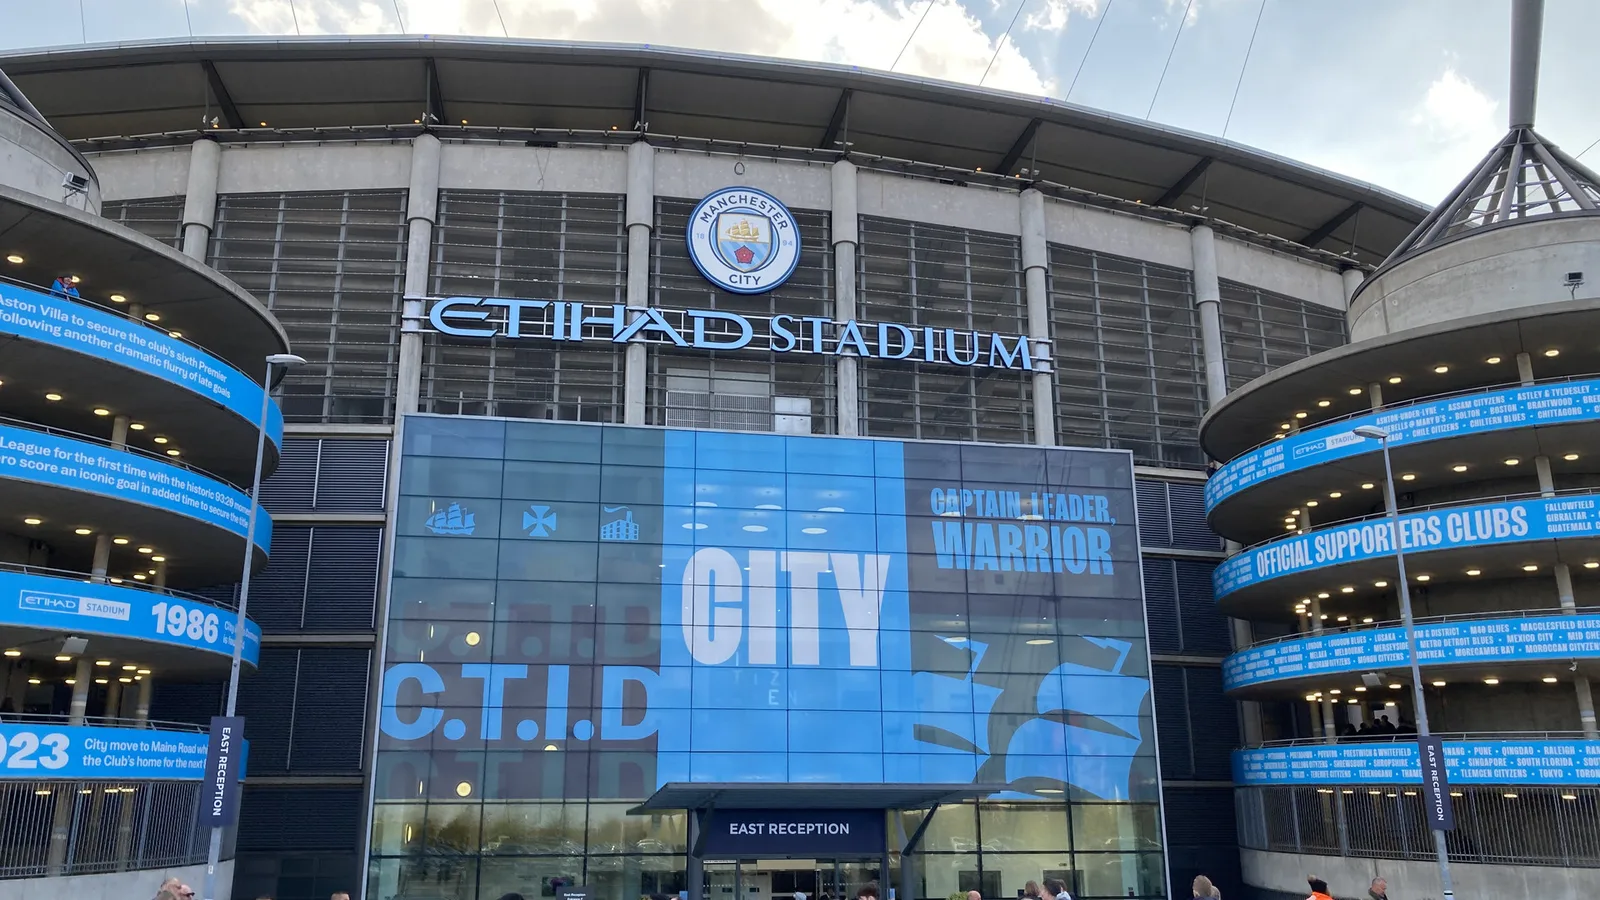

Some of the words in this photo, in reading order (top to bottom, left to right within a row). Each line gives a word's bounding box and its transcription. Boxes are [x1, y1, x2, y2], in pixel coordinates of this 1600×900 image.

[700, 195, 788, 229] MANCHESTER
[729, 274, 761, 285] CITY
[0, 294, 36, 314] Aston
[40, 304, 68, 323] Villa
[71, 314, 85, 326] to
[87, 320, 127, 340] secure
[128, 332, 147, 347] the
[148, 340, 176, 358] club's
[176, 351, 198, 368] sixth
[199, 360, 227, 383] Premier
[429, 297, 754, 350] ETIHAD
[770, 314, 1034, 371] STADIUM
[0, 309, 61, 337] following
[64, 329, 113, 349] another
[114, 342, 162, 367] dramatic
[163, 359, 189, 380] flurry
[189, 369, 198, 381] of
[198, 373, 213, 388] late
[213, 382, 231, 399] goals
[1448, 400, 1471, 411] ASSAM
[1473, 396, 1505, 408] CITYZENS
[1517, 391, 1543, 401] ASTLEY
[1544, 389, 1550, 398] &
[1552, 385, 1590, 397] TYLDESLEY
[1412, 427, 1430, 438] CHILE
[1470, 415, 1502, 428] CHILTERN
[1503, 412, 1526, 424] BLUES
[1537, 406, 1582, 419] CHITTAGONG
[1416, 416, 1434, 426] MARY
[1455, 410, 1480, 420] BOLTON
[1490, 404, 1517, 415] BOSTON
[1527, 398, 1572, 410] BRANTWOOD
[1295, 442, 1325, 456] ETIHAD
[0, 436, 51, 456] League
[53, 446, 72, 460] for
[75, 451, 95, 466] the
[97, 456, 121, 471] first
[123, 463, 147, 478] time
[148, 470, 170, 484] with
[171, 476, 186, 489] the
[186, 480, 215, 500] historic
[234, 501, 251, 516] momen
[19, 458, 58, 473] score
[60, 466, 77, 477] an
[79, 467, 115, 486] iconic
[116, 478, 139, 491] goal
[141, 482, 151, 494] in
[152, 485, 181, 504] added
[182, 494, 200, 510] time
[200, 500, 208, 512] to
[209, 504, 230, 520] secure
[1032, 491, 1116, 527] LEADER,
[1544, 500, 1595, 512] FALLOWFIELD
[1546, 511, 1587, 522] GIBRALTAR
[1547, 522, 1592, 533] GUATEMALA
[931, 521, 1114, 575] WARRIOR
[1256, 539, 1313, 578] OFFICIAL
[1314, 515, 1443, 563] SUPPORTERS
[1446, 506, 1529, 543] CLUBS
[25, 596, 76, 609] ETIHAD
[86, 603, 125, 616] STADIUM
[681, 547, 891, 667] CITY
[152, 601, 219, 644] 1986
[1431, 627, 1460, 637] DISTRICT
[1487, 624, 1510, 634] BLUES
[1520, 620, 1576, 631] MACCLESFIELD
[1577, 619, 1600, 629] BLUES
[1420, 638, 1443, 649] METRO
[1444, 637, 1470, 647] DETROIT
[1472, 635, 1494, 645] BLUES
[1506, 633, 1536, 643] MEXICO
[1537, 632, 1554, 642] CITY
[1567, 631, 1583, 641] MID
[1455, 646, 1500, 657] MORECAMBE
[1501, 645, 1515, 655] BAY
[1525, 643, 1568, 653] MOROCCAN
[379, 662, 660, 741] C.T.I.D
[84, 738, 108, 753] City
[109, 741, 138, 752] move
[140, 741, 150, 752] to
[151, 741, 177, 753] Maine
[177, 742, 197, 754] Road
[220, 727, 231, 754] EAST
[1378, 747, 1411, 756] WHITEFIELD
[1474, 747, 1492, 756] PUNE
[1502, 746, 1534, 756] QINGDAO
[1544, 746, 1575, 755] RALEIGH
[83, 754, 101, 767] the
[104, 754, 135, 768] Club's
[136, 757, 162, 768] home
[163, 757, 175, 768] for
[175, 758, 187, 769] the
[187, 759, 204, 770] next
[1427, 745, 1438, 769] EAST
[1468, 758, 1507, 767] SINGAPORE
[1517, 757, 1541, 767] SOUTH
[1541, 757, 1574, 767] FLORIDA
[213, 756, 228, 816] RECEPTION
[1494, 769, 1528, 778] CITYZENS
[1539, 769, 1564, 778] TOKYO
[1431, 771, 1445, 822] RECEPTION
[729, 822, 765, 835] EAST
[769, 822, 850, 835] RECEPTION
